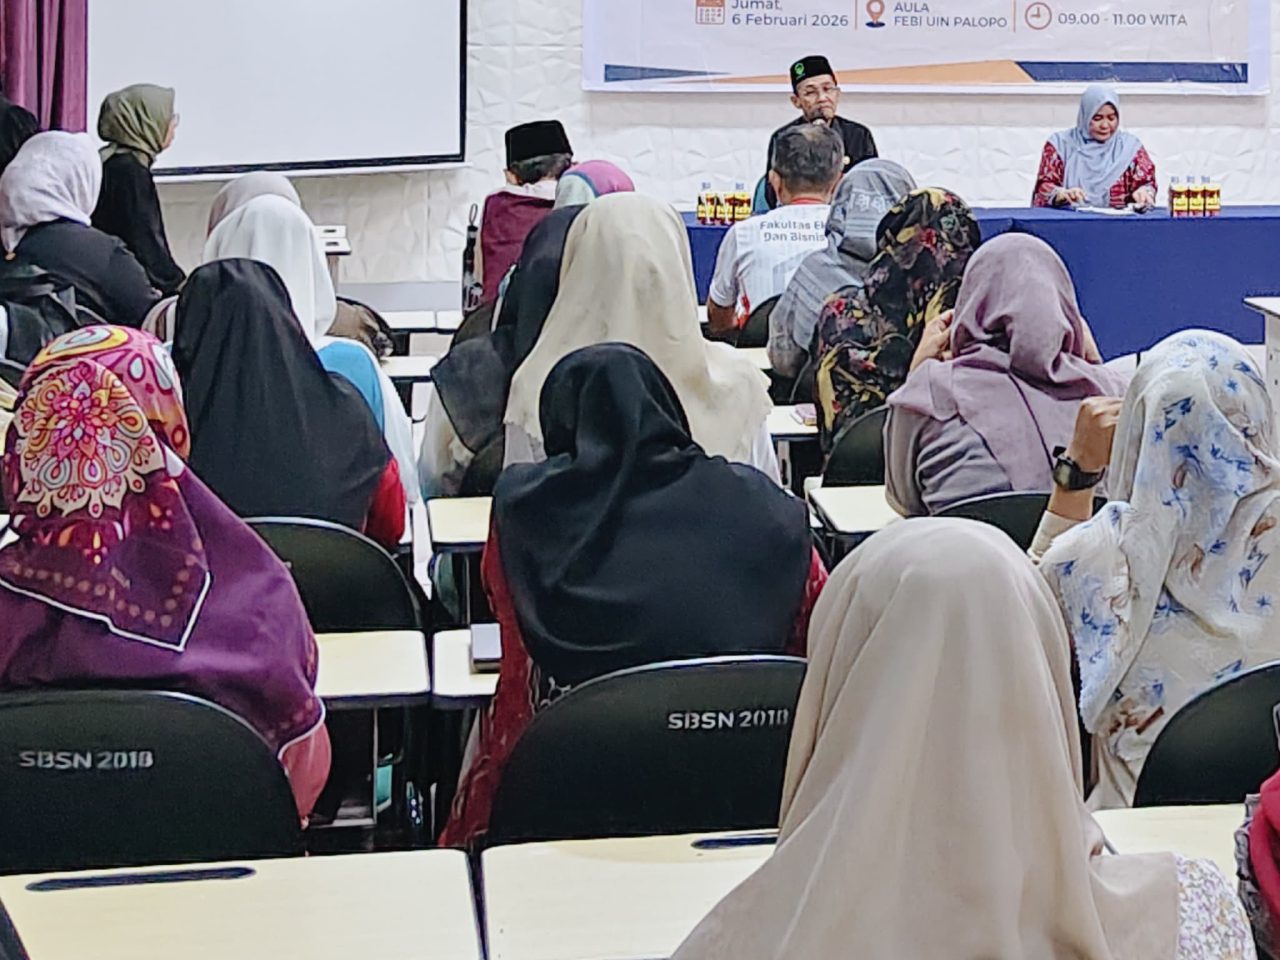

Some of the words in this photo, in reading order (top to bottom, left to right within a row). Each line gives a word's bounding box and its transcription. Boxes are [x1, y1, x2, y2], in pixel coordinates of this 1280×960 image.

[893, 2, 930, 14] AULA
[731, 13, 742, 26] 6
[745, 13, 808, 27] Februari
[811, 14, 849, 27] 2026
[894, 15, 923, 27] FEBI
[926, 16, 950, 28] UIN
[953, 16, 1008, 28] PALOPO
[1057, 12, 1101, 26] 09.00
[1112, 13, 1146, 26] 11.00
[1149, 13, 1188, 26] WITA
[759, 220, 811, 230] Fakultas
[763, 233, 788, 242] Dan
[792, 232, 825, 242] Bisnis
[668, 711, 735, 730] SBSN
[18, 750, 93, 769] SBSN
